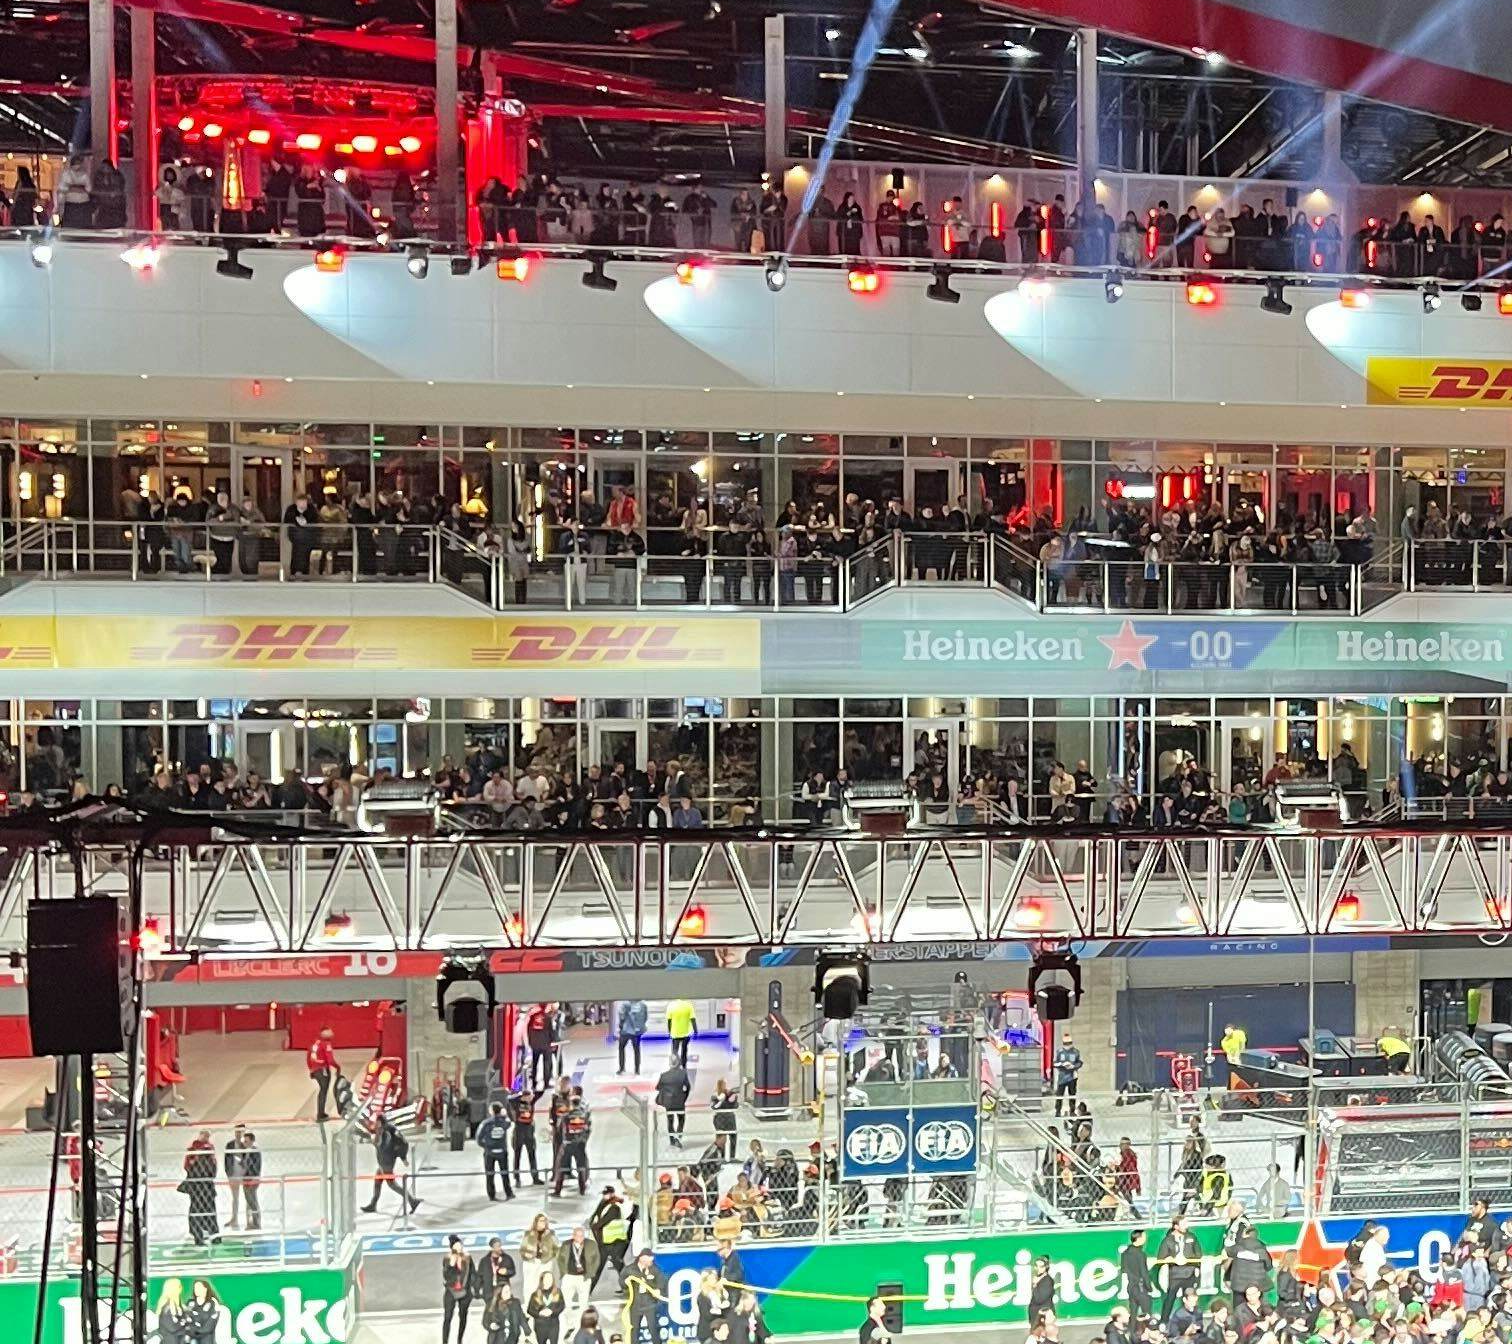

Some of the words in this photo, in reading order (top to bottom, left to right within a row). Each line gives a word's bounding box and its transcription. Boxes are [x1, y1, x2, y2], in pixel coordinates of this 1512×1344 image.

[166, 623, 362, 662] DHL
[507, 625, 697, 662] DHL
[902, 629, 1085, 662] Heineken
[1336, 630, 1504, 662] Heineken
[871, 941, 1003, 961] ERSTAPPEN
[1209, 942, 1279, 952] RACING
[212, 957, 331, 978] LECLERC
[850, 1132, 900, 1158] FIA
[919, 1129, 968, 1156] FIA
